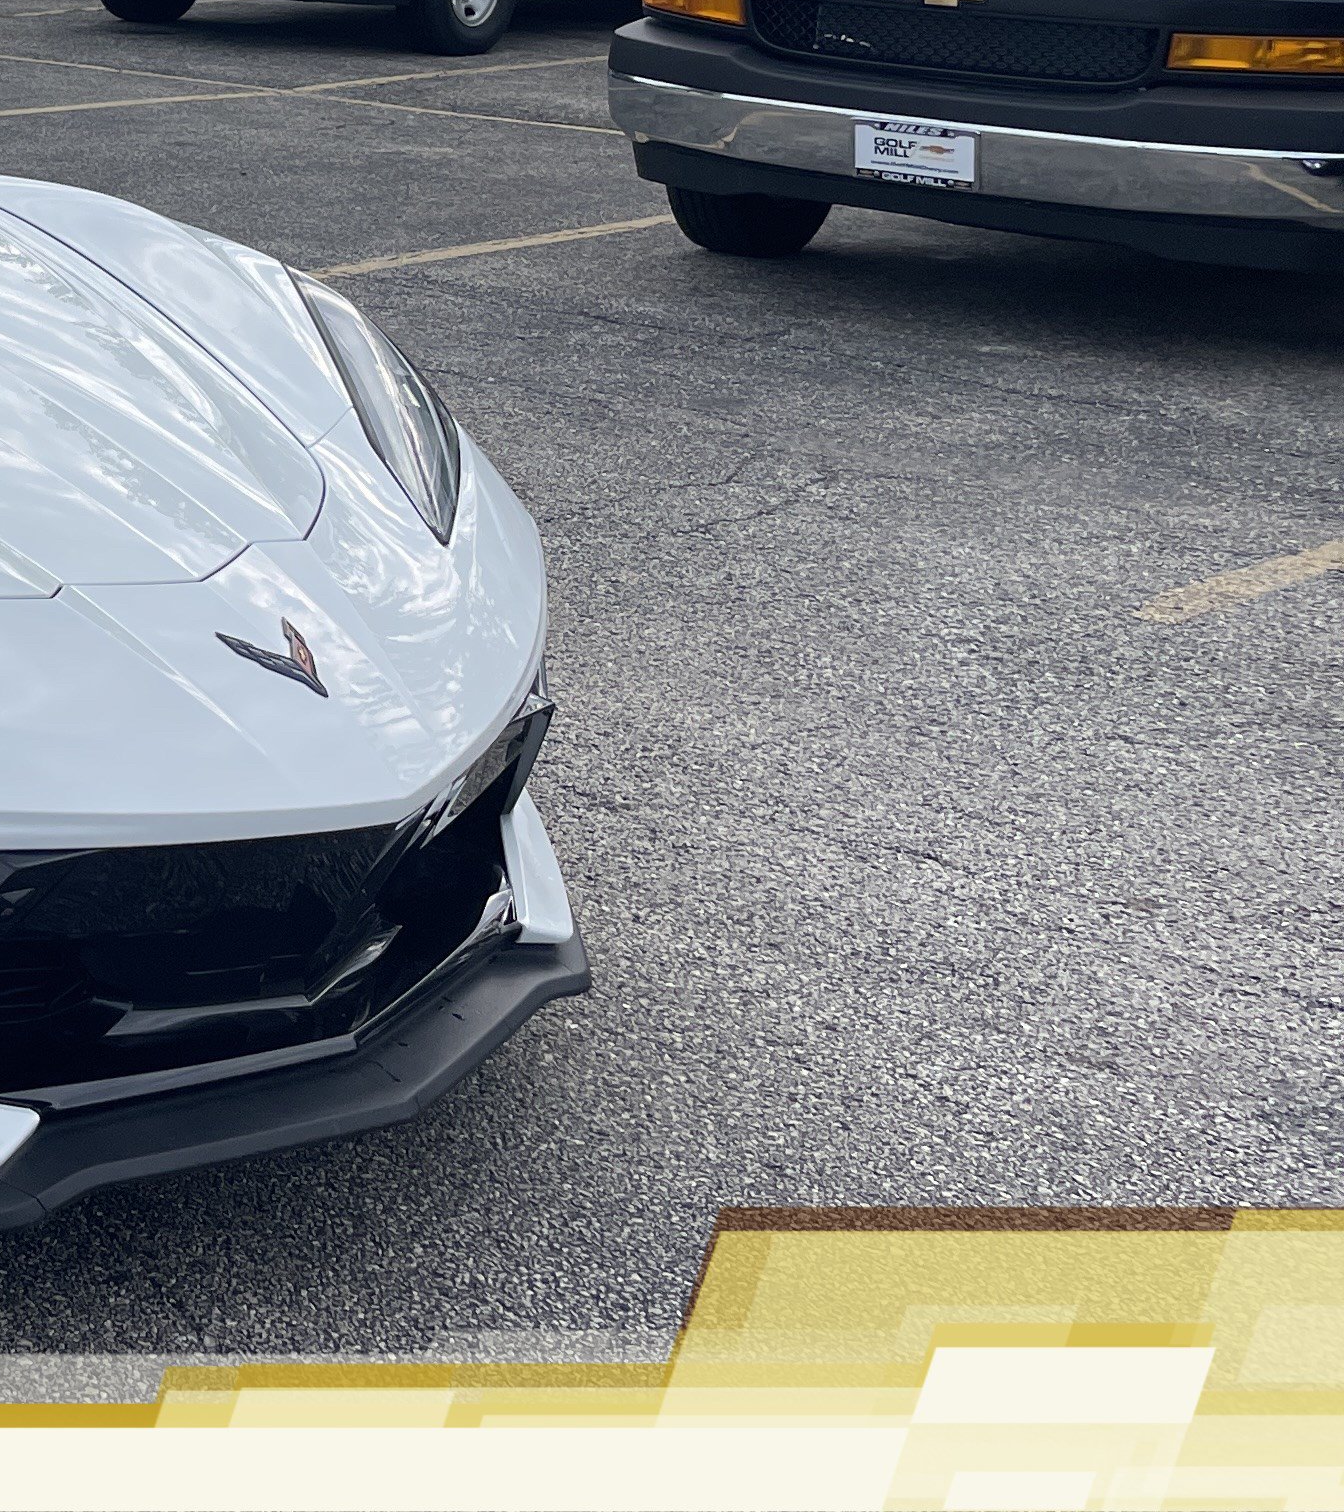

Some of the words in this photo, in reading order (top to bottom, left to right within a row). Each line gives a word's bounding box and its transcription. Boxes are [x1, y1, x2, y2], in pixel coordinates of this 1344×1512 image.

[884, 123, 944, 136] NILES
[874, 137, 917, 149] GOLF
[874, 146, 910, 158] MILL
[881, 172, 915, 183] GOLF
[915, 175, 947, 187] MILL
